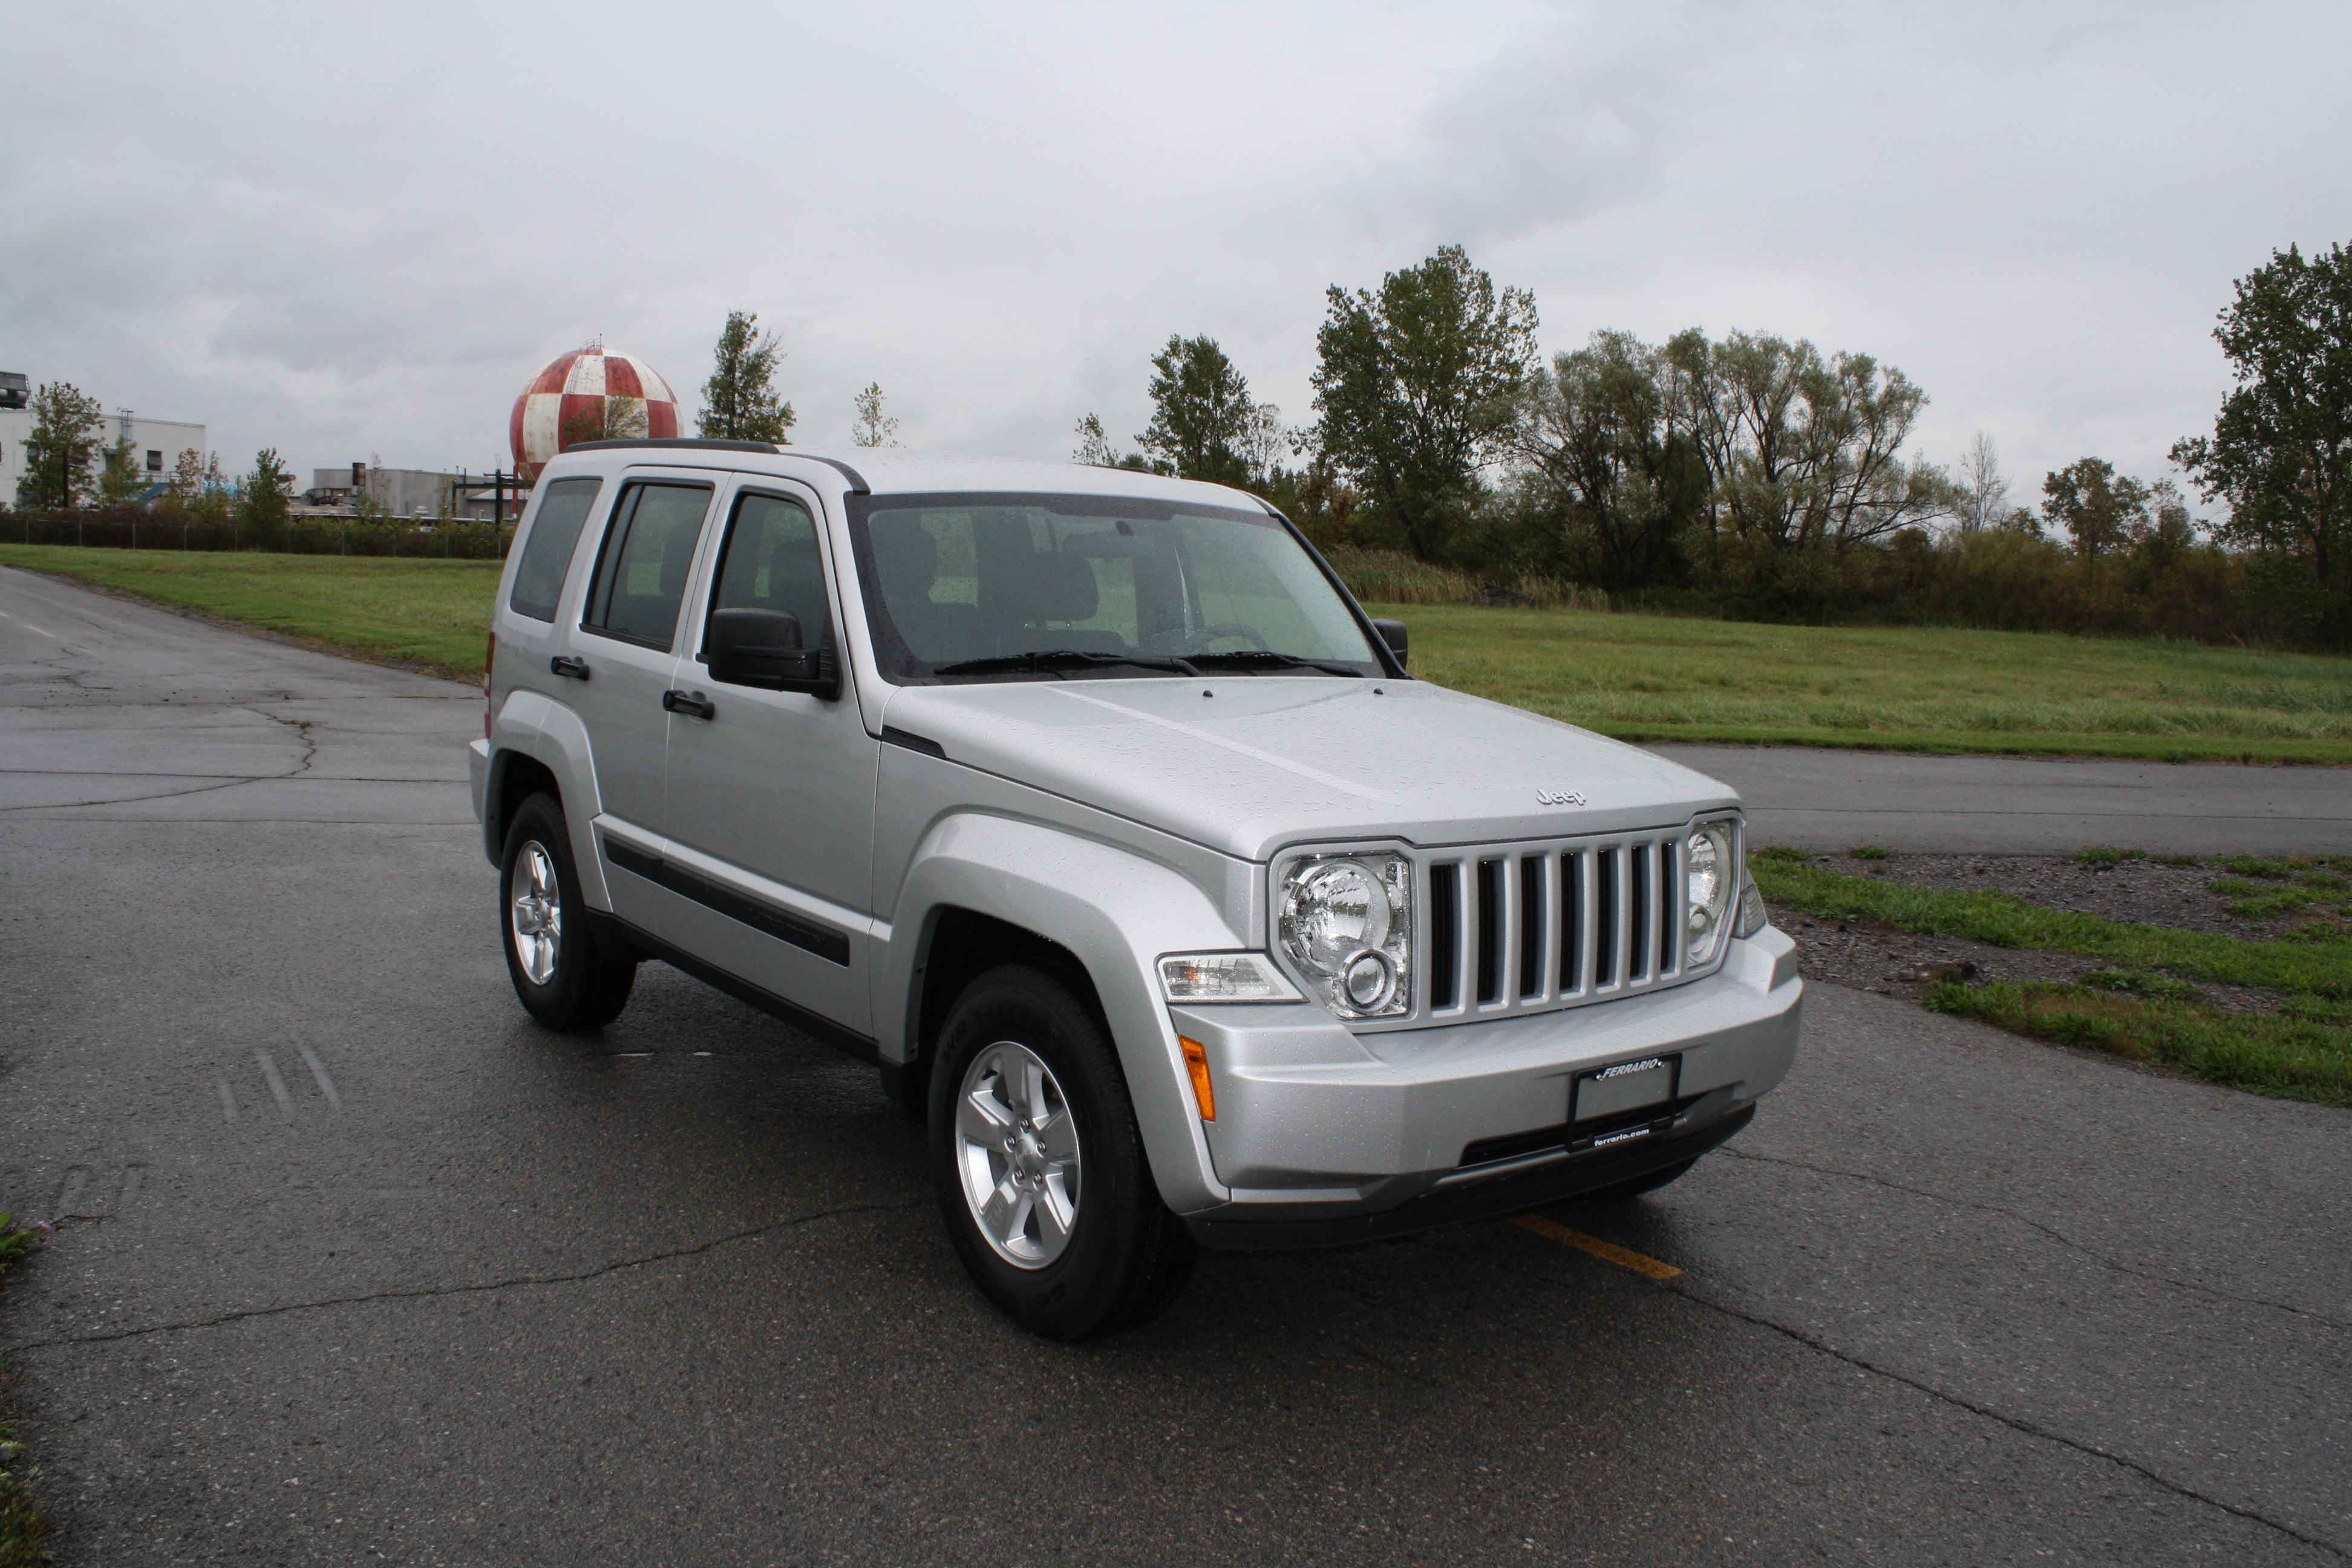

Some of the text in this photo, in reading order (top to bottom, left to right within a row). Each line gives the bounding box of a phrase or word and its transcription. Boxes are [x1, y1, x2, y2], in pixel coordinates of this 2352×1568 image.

[1537, 788, 1586, 806] Jeep
[1602, 1058, 1658, 1079] FERRARIO
[1594, 1129, 1650, 1146] ferrario.com
